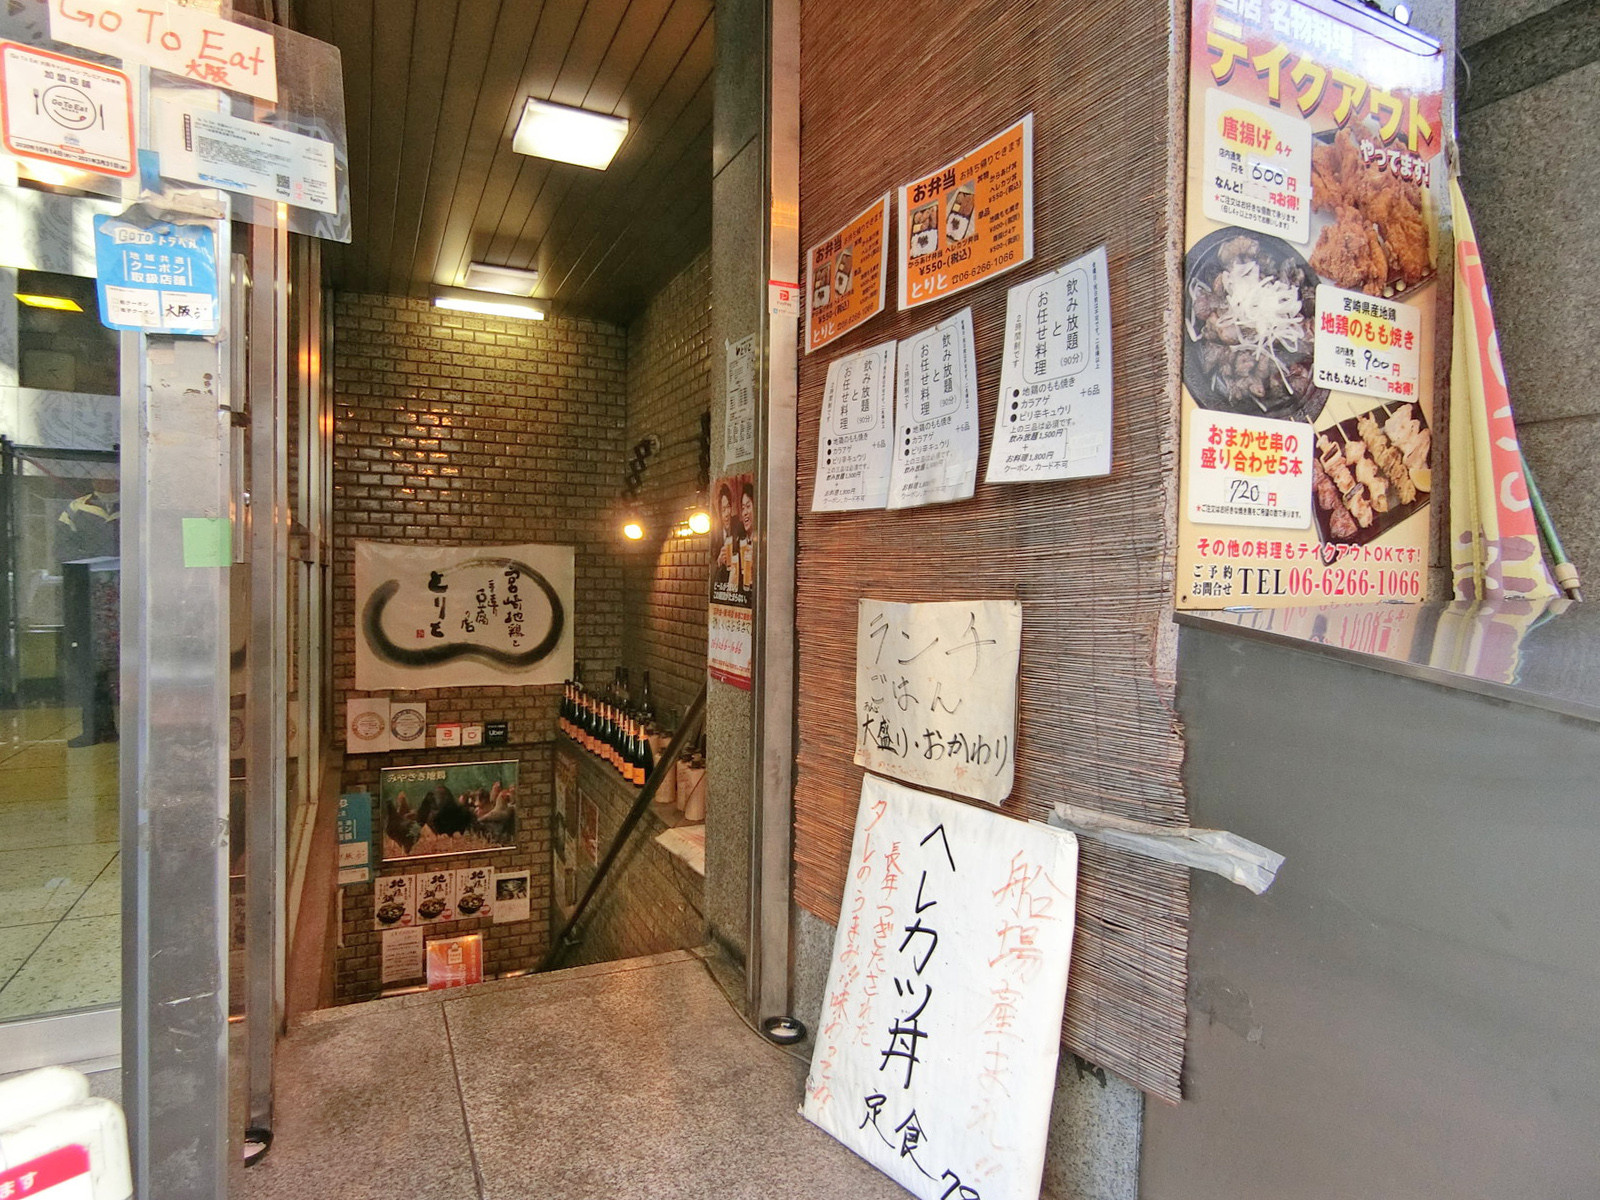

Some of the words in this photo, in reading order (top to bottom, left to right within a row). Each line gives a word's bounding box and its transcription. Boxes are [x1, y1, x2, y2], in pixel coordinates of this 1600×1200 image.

[199, 29, 265, 77] Eat
[185, 59, 233, 87] 大阪
[1206, 16, 1433, 153] テイクアウト
[1222, 115, 1272, 152] 唐揚げ
[1252, 162, 1284, 186] 600
[1286, 176, 1297, 193] 円
[1360, 139, 1431, 189] やってます!
[912, 167, 957, 204] お弁当
[1214, 175, 1244, 195] なんと!
[131, 260, 185, 275] クーポン
[131, 271, 187, 287] 取扱店舗
[911, 272, 949, 300] とりと
[1064, 277, 1080, 352] 飲み放題
[1343, 296, 1397, 322] 宮崎県産地鶏
[812, 320, 836, 343] とりと
[1033, 291, 1049, 377] お任せ料理
[1052, 320, 1063, 338] と
[1320, 311, 1415, 351] 地鶏のもも焼き
[942, 334, 953, 394] 飲み放題
[1363, 348, 1390, 371] 900
[1391, 362, 1401, 377] 円
[860, 360, 873, 413] 飲み放題
[920, 343, 931, 417] お任せ料理
[1021, 376, 1076, 397] 地鶏のもも焼き
[1020, 395, 1051, 410] カラアゲ
[1207, 423, 1299, 455] おまかせ串の
[1200, 447, 1303, 479] 盛り合わせ5本
[1229, 479, 1261, 503] 720
[1267, 492, 1278, 507] 円
[1197, 537, 1421, 564] その他の料理もテイクアウトOKです!
[1193, 564, 1233, 580] ご予約
[1236, 567, 1288, 596] TEL
[1288, 567, 1420, 597] 06-6266-1066
[1192, 581, 1233, 597] お問合せ
[869, 611, 997, 681] ランチ
[870, 672, 964, 713] ごはん
[862, 713, 1008, 778] 大盛り・おかわり
[880, 823, 957, 1090] ヘレカツ丼
[858, 1087, 939, 1182] 定食
